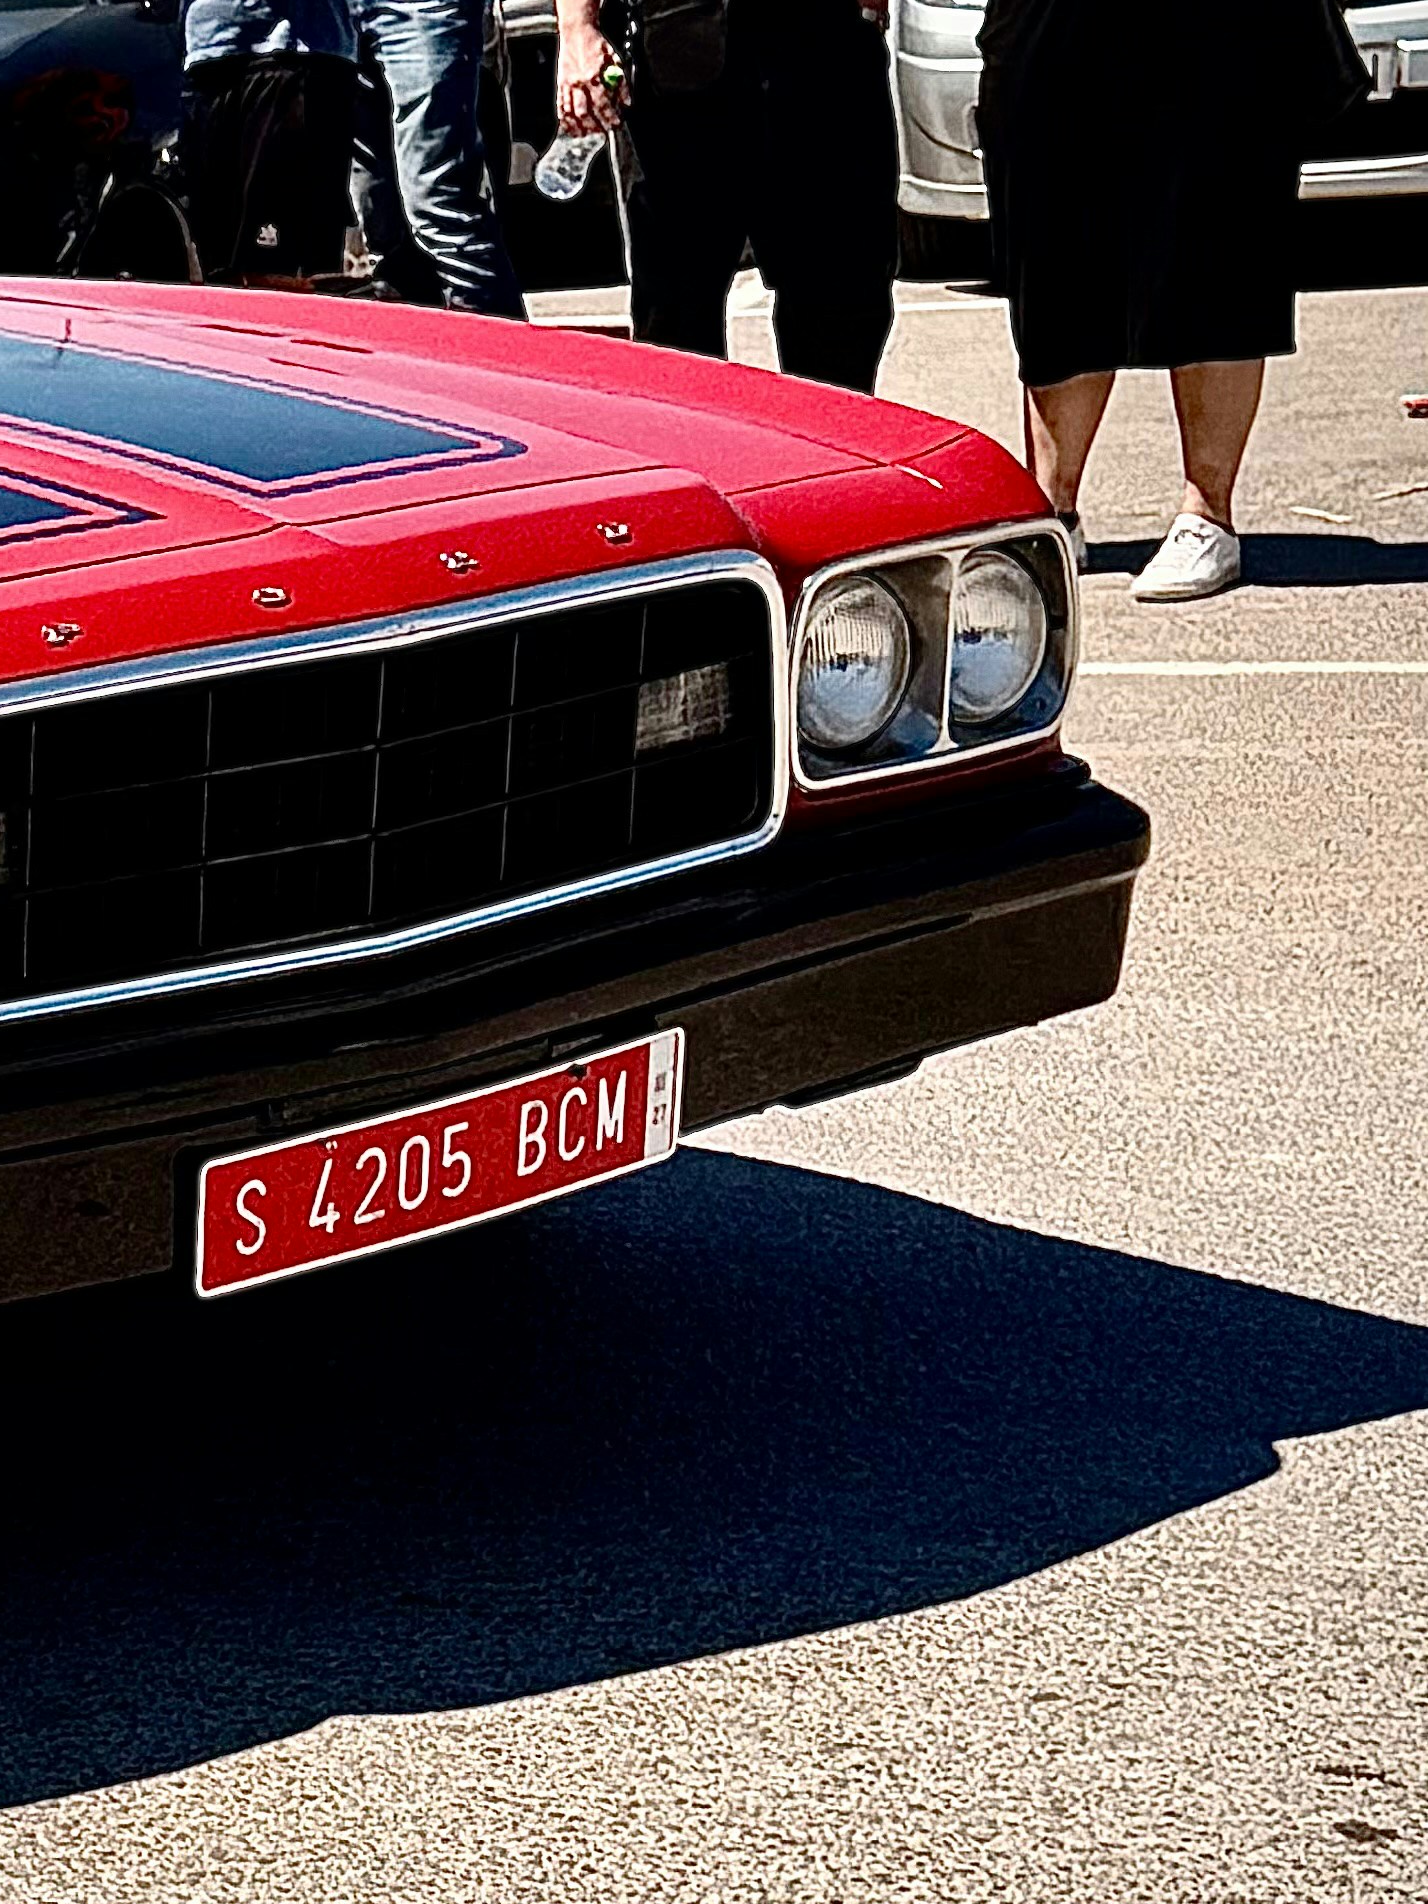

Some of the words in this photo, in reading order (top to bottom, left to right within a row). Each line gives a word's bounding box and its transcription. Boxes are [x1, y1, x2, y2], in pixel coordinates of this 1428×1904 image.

[235, 1179, 268, 1256] S
[308, 1121, 472, 1234] 4205
[517, 1069, 628, 1177] BCM
